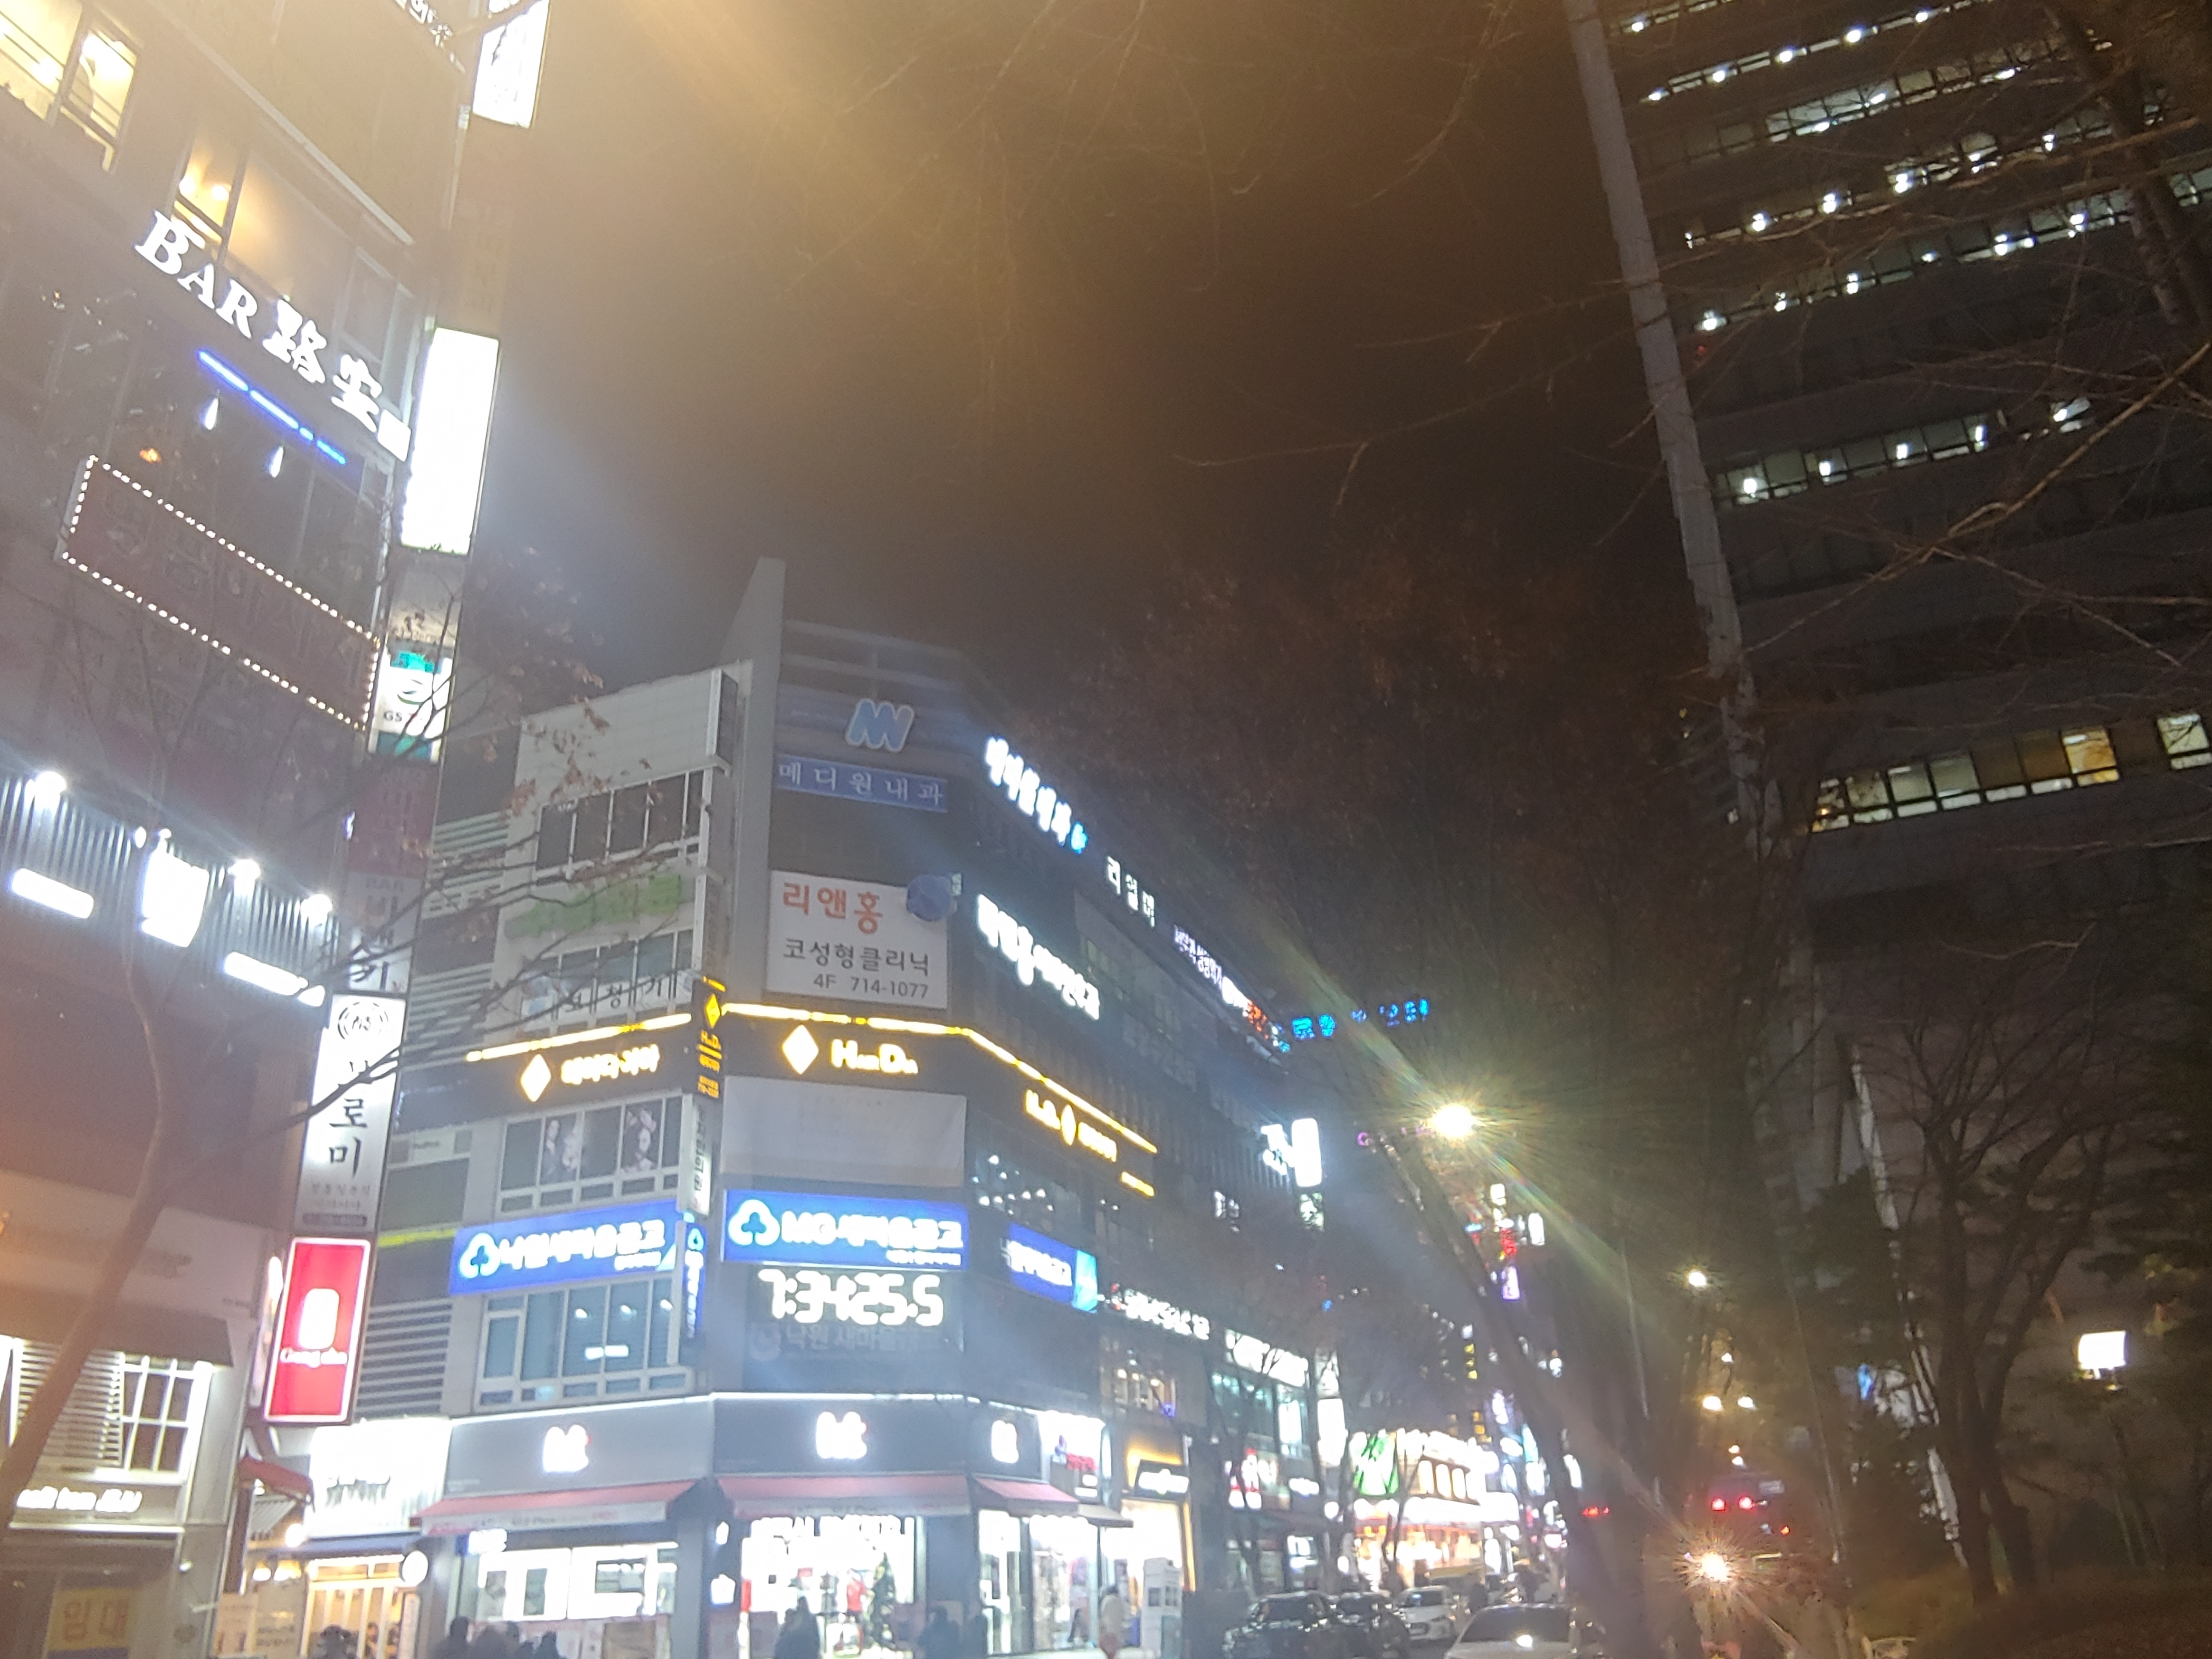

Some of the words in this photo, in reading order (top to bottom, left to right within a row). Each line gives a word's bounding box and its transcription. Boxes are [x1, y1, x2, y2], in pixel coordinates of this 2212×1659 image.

[134, 209, 258, 339] BAR
[779, 761, 944, 806] 메디원내과
[783, 882, 883, 934] 리앤홍
[783, 937, 928, 977] 코성형클리닉
[813, 973, 837, 989] 4F
[851, 976, 928, 999] 714-1077
